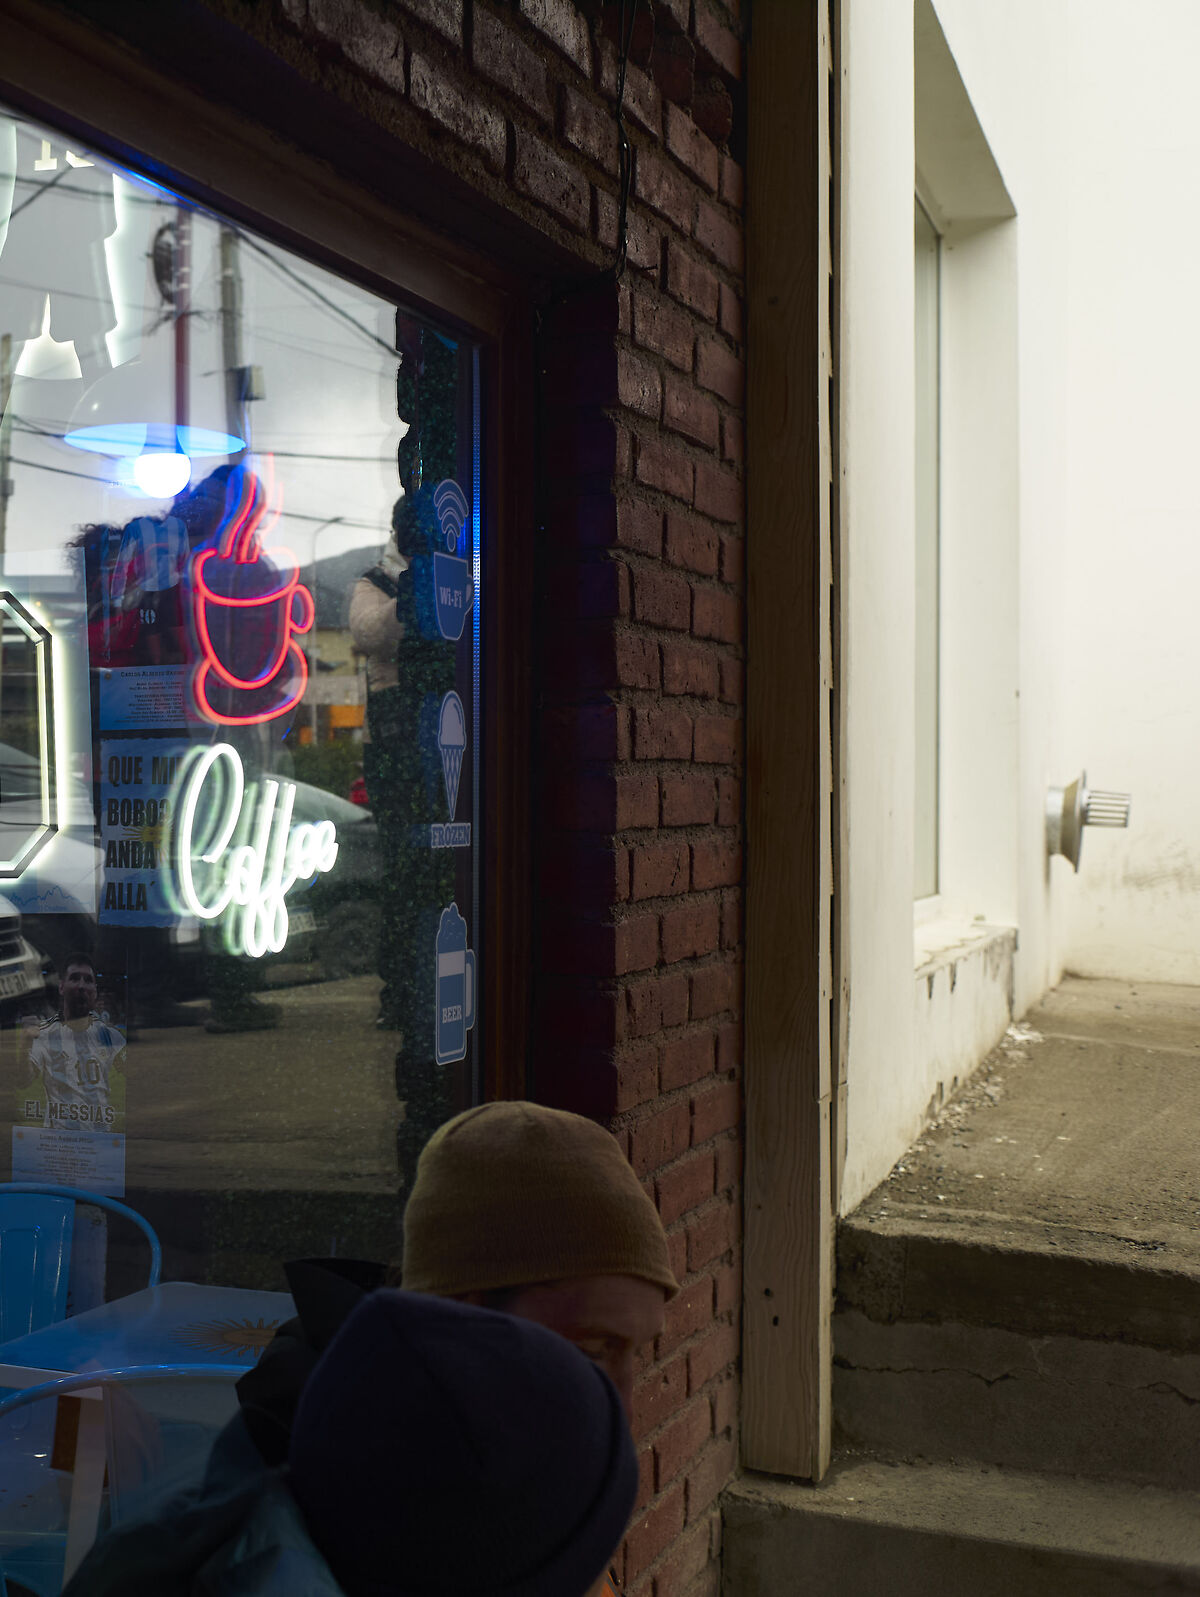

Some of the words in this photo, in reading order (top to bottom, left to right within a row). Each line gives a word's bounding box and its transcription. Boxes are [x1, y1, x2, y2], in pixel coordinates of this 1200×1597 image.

[107, 756, 143, 787] QUE
[431, 823, 471, 848] FROZEN
[176, 743, 338, 957] Coffee
[441, 1004, 463, 1024] BEER
[74, 1056, 100, 1086] 10
[25, 1100, 43, 1118] EL
[48, 1102, 115, 1124] MESSIAS
